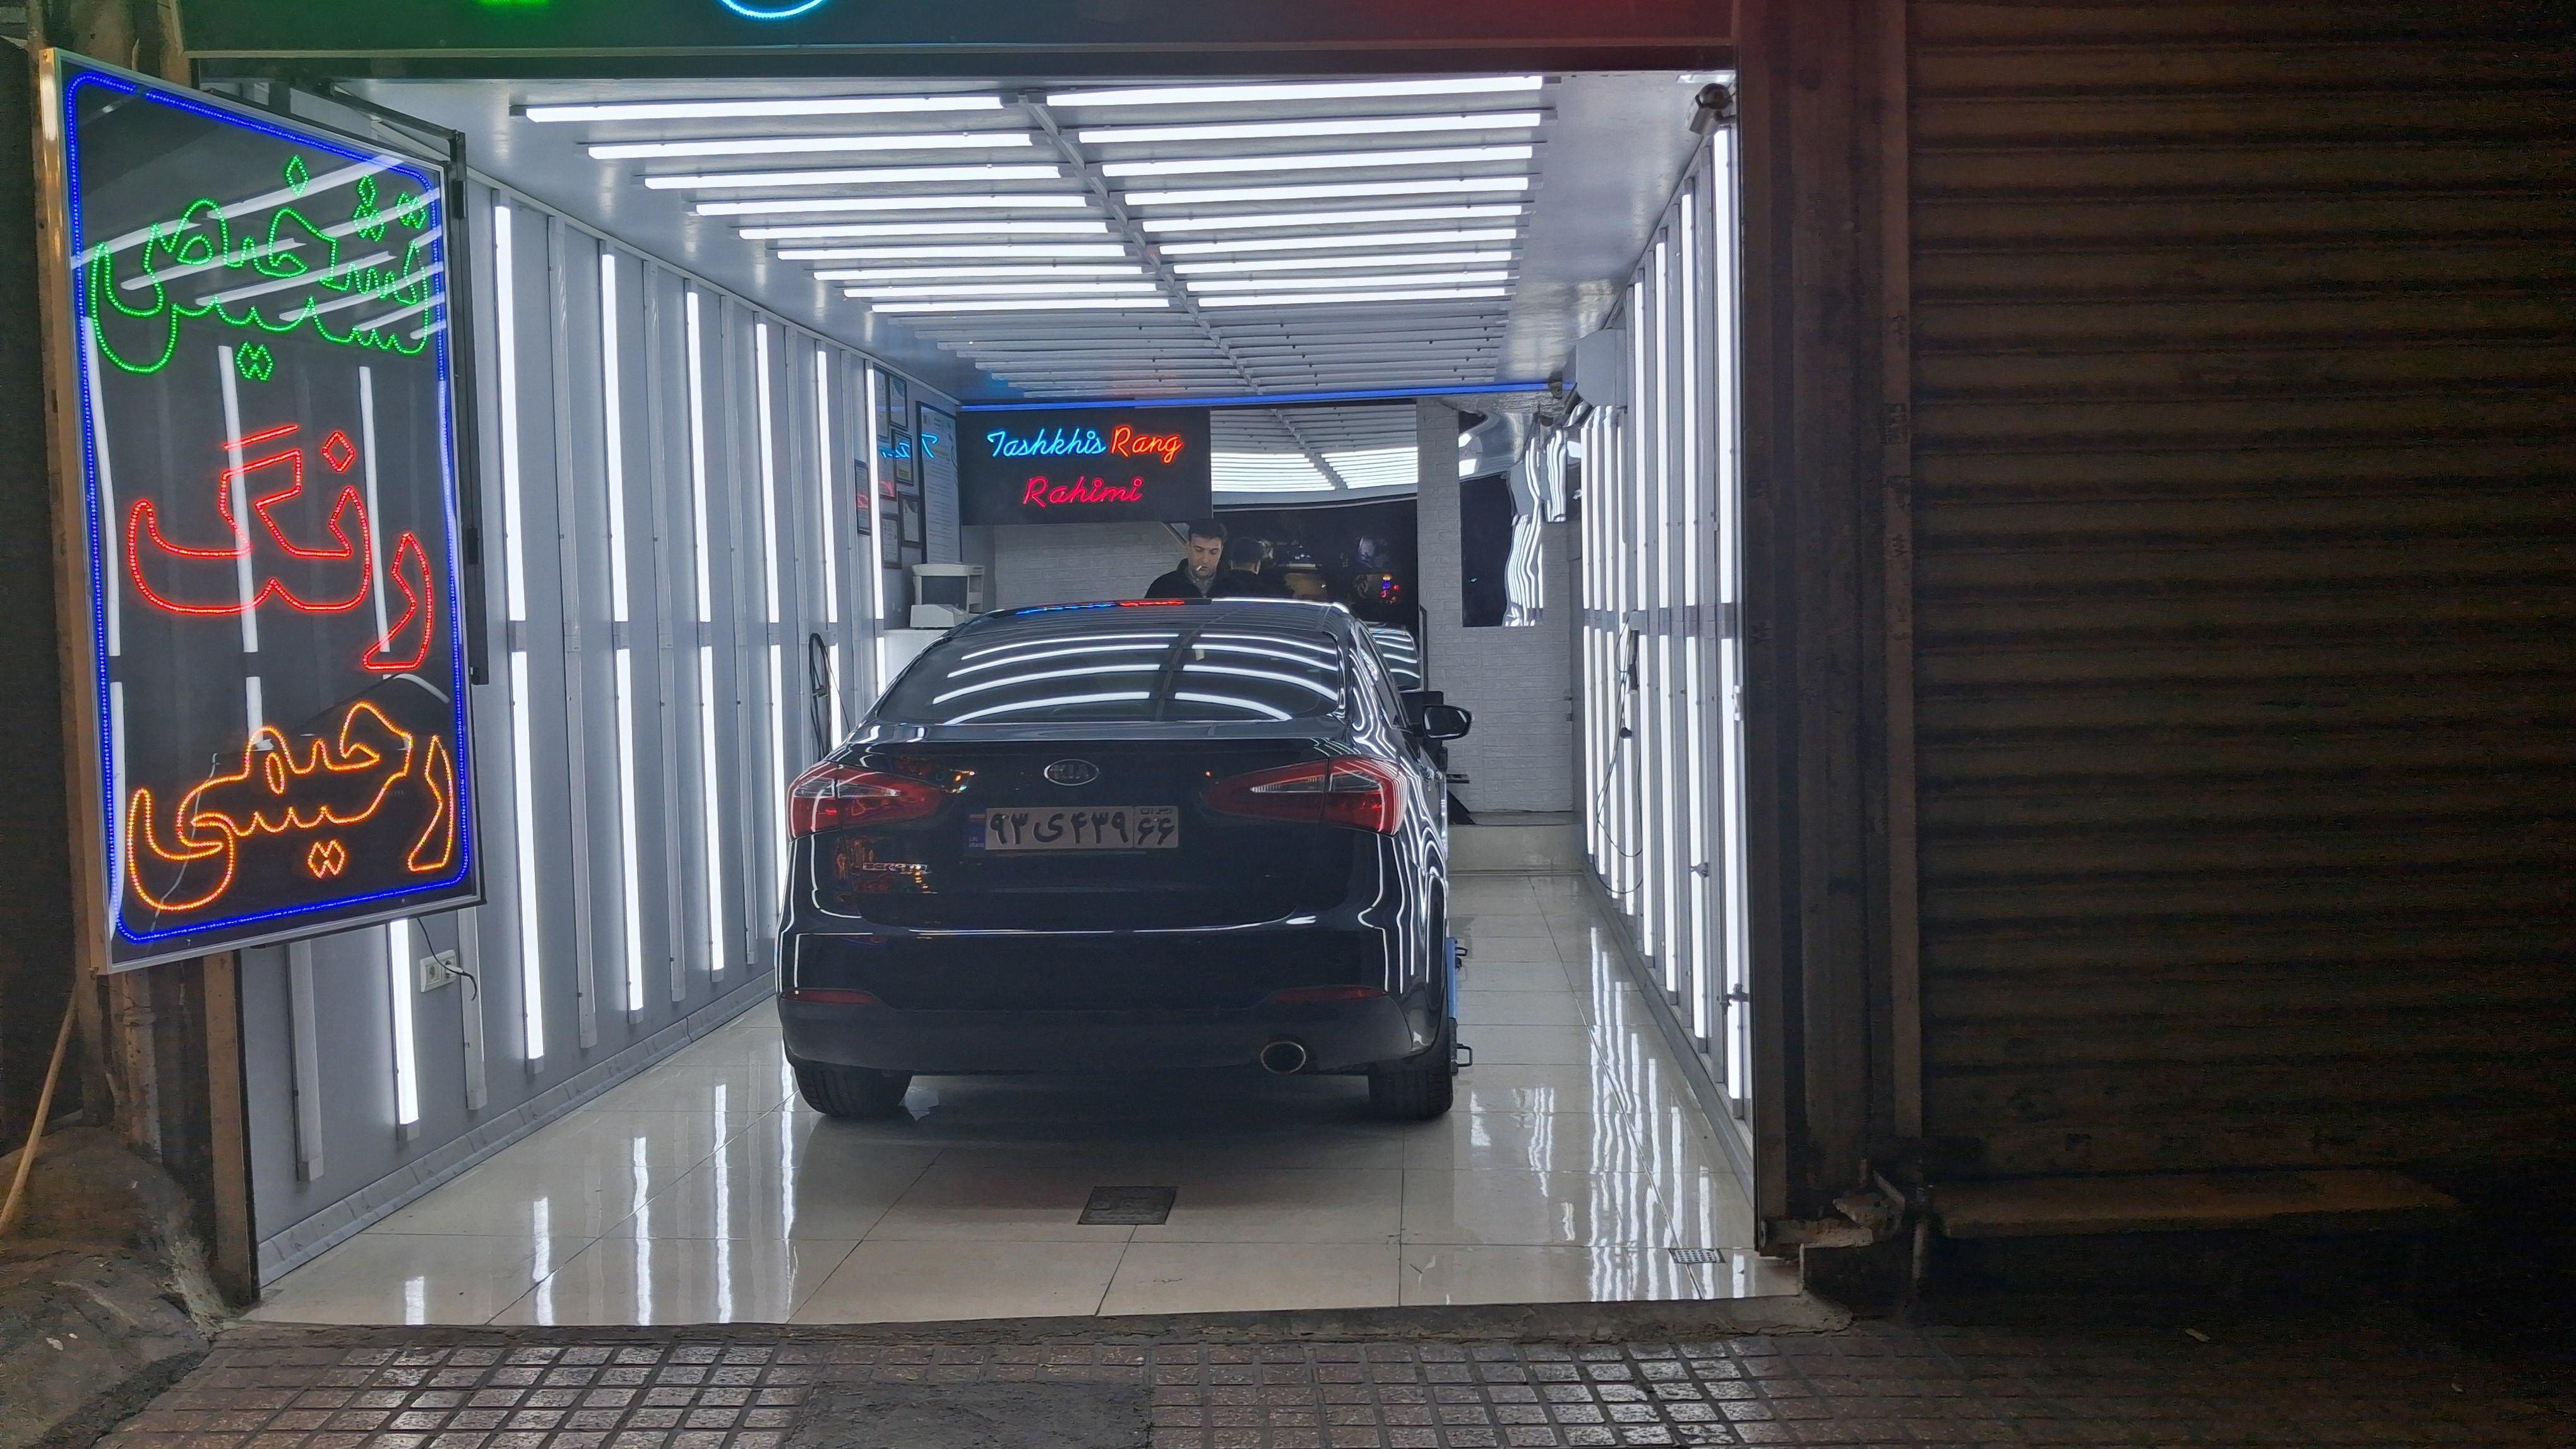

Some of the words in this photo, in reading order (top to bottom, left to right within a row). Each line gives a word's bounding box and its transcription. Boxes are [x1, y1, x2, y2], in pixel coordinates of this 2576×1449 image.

[90, 154, 431, 383] تشخیص
[986, 427, 1107, 458] Tashkhis
[1109, 424, 1184, 465] Rang
[1022, 475, 1145, 509] Rahimi
[128, 424, 433, 671] رنگ
[128, 701, 455, 911] رحیمی
[1048, 764, 1090, 780] KIA
